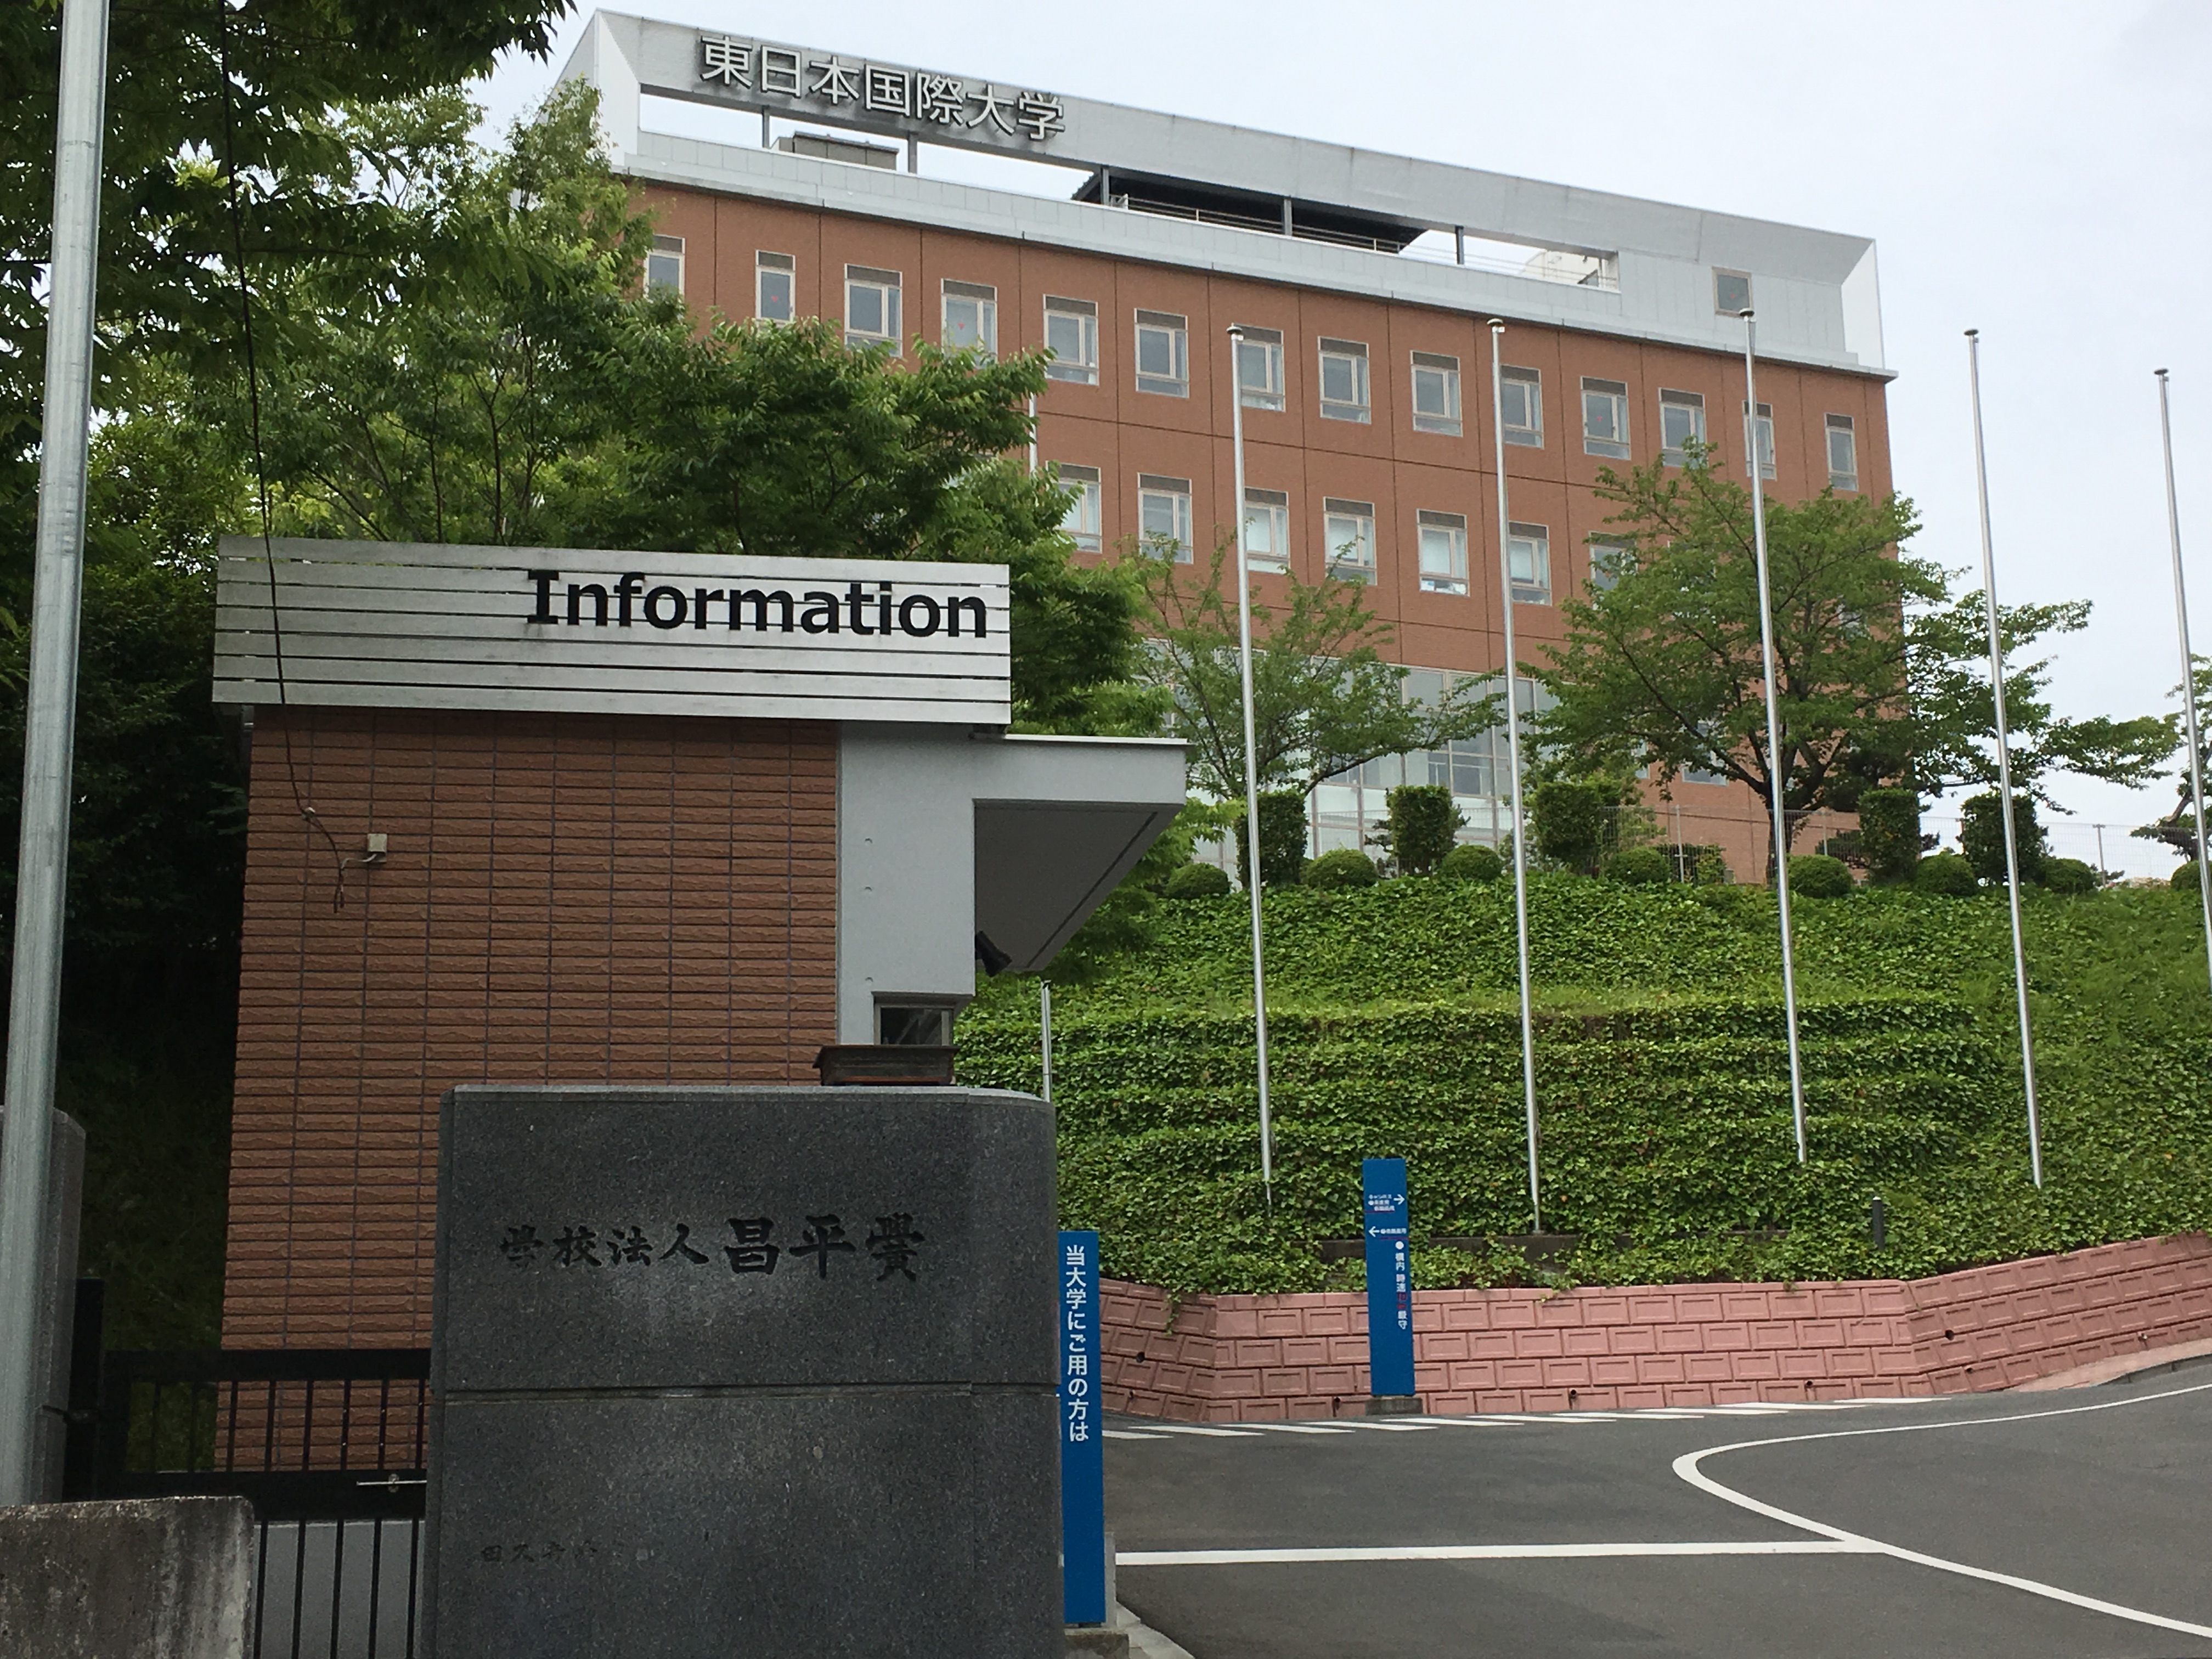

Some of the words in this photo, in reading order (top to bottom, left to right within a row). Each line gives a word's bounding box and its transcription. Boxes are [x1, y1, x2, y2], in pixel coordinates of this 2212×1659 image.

[700, 35, 1065, 140] 東日本国際大学
[527, 569, 987, 639] Information
[1065, 1244, 1089, 1442] 当大学にご用の方は
